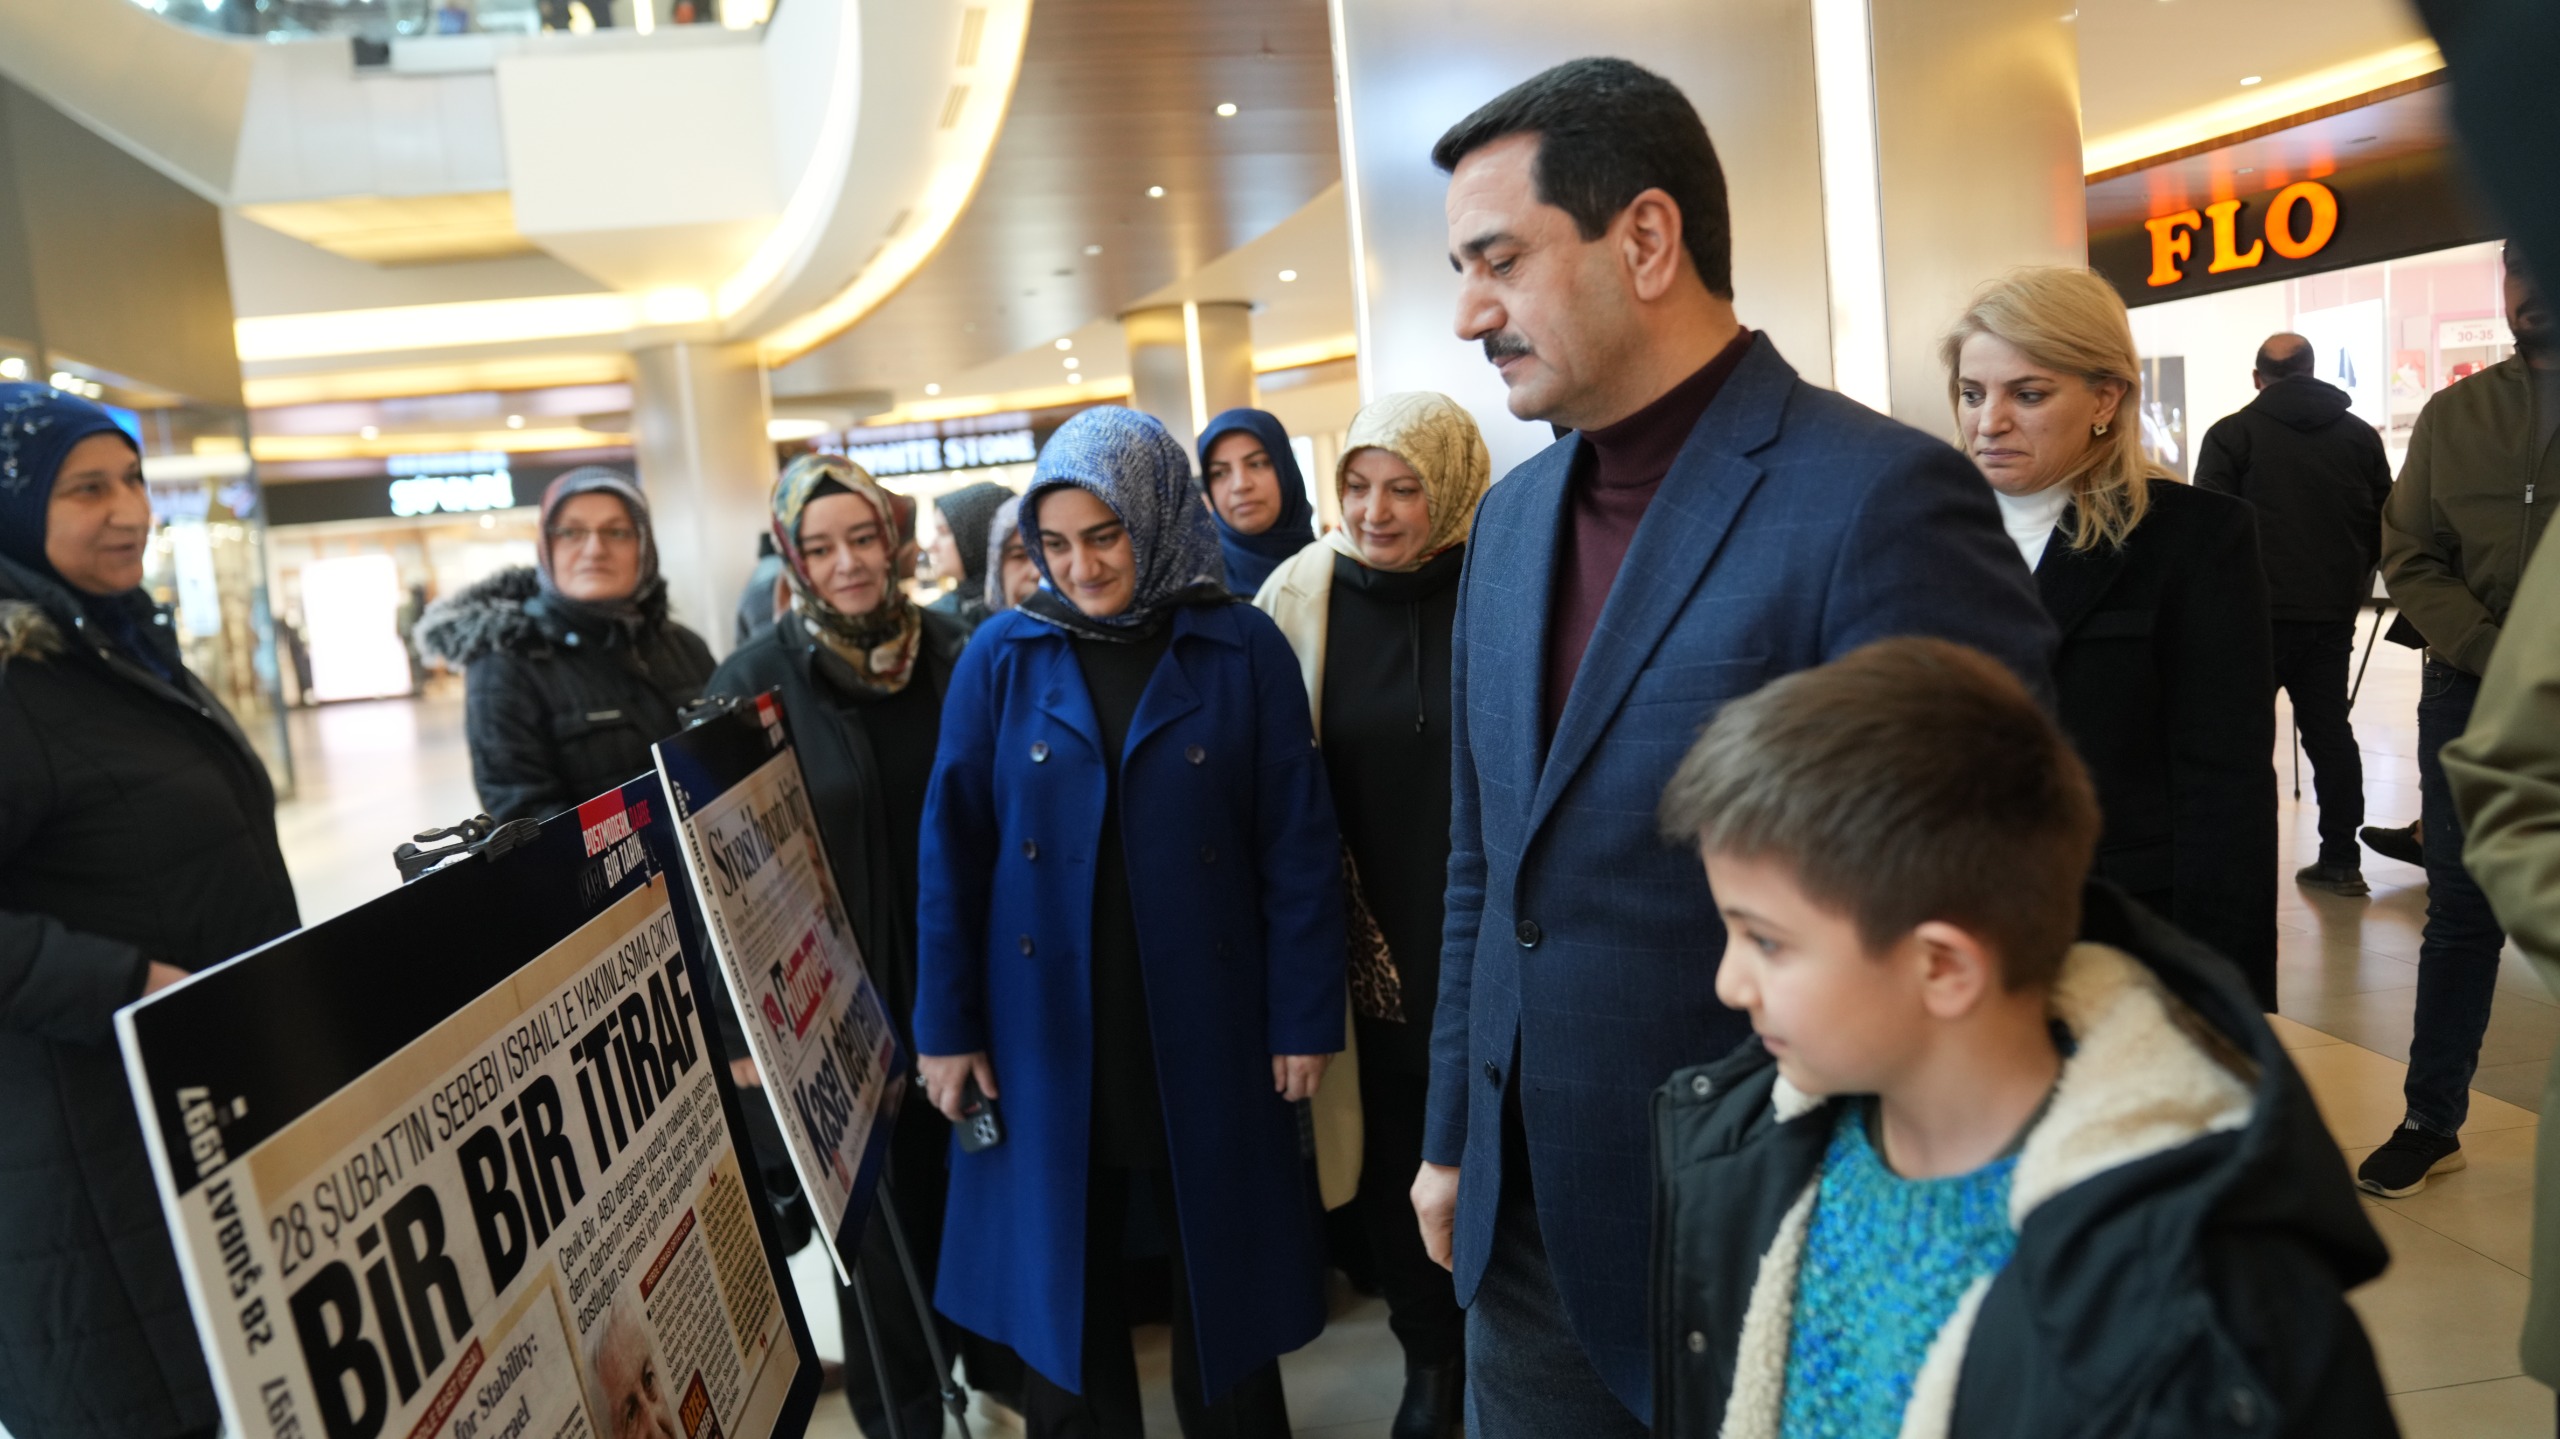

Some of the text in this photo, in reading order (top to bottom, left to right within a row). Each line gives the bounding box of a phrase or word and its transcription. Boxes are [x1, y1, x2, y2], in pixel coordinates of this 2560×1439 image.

[2144, 180, 2339, 287] FLO
[582, 810, 632, 858] POSTMODERN
[603, 845, 622, 889] BİR
[708, 807, 762, 907] Siyasi
[269, 1202, 314, 1279] 28
[314, 1105, 434, 1250] ŞUBAT'IN
[574, 932, 653, 1022] YAKINLAŞMA
[649, 910, 679, 966] ÇIKTI
[792, 1033, 853, 1181] Kaset
[176, 1086, 273, 1357] 28 ŞUBAT 1997
[287, 1184, 475, 1439] BİR
[456, 1074, 586, 1299] BİR
[569, 950, 698, 1175] İTİRAF
[559, 1231, 585, 1276] Çevik
[597, 1190, 616, 1227] ABD
[615, 1156, 647, 1204] dergisine
[589, 1223, 624, 1277] darbenin
[623, 1190, 649, 1232] sadece
[618, 1223, 648, 1278] sürmesi
[644, 1210, 661, 1238] için
[658, 1198, 669, 1220] de
[453, 1333, 538, 1439] for Stability:
